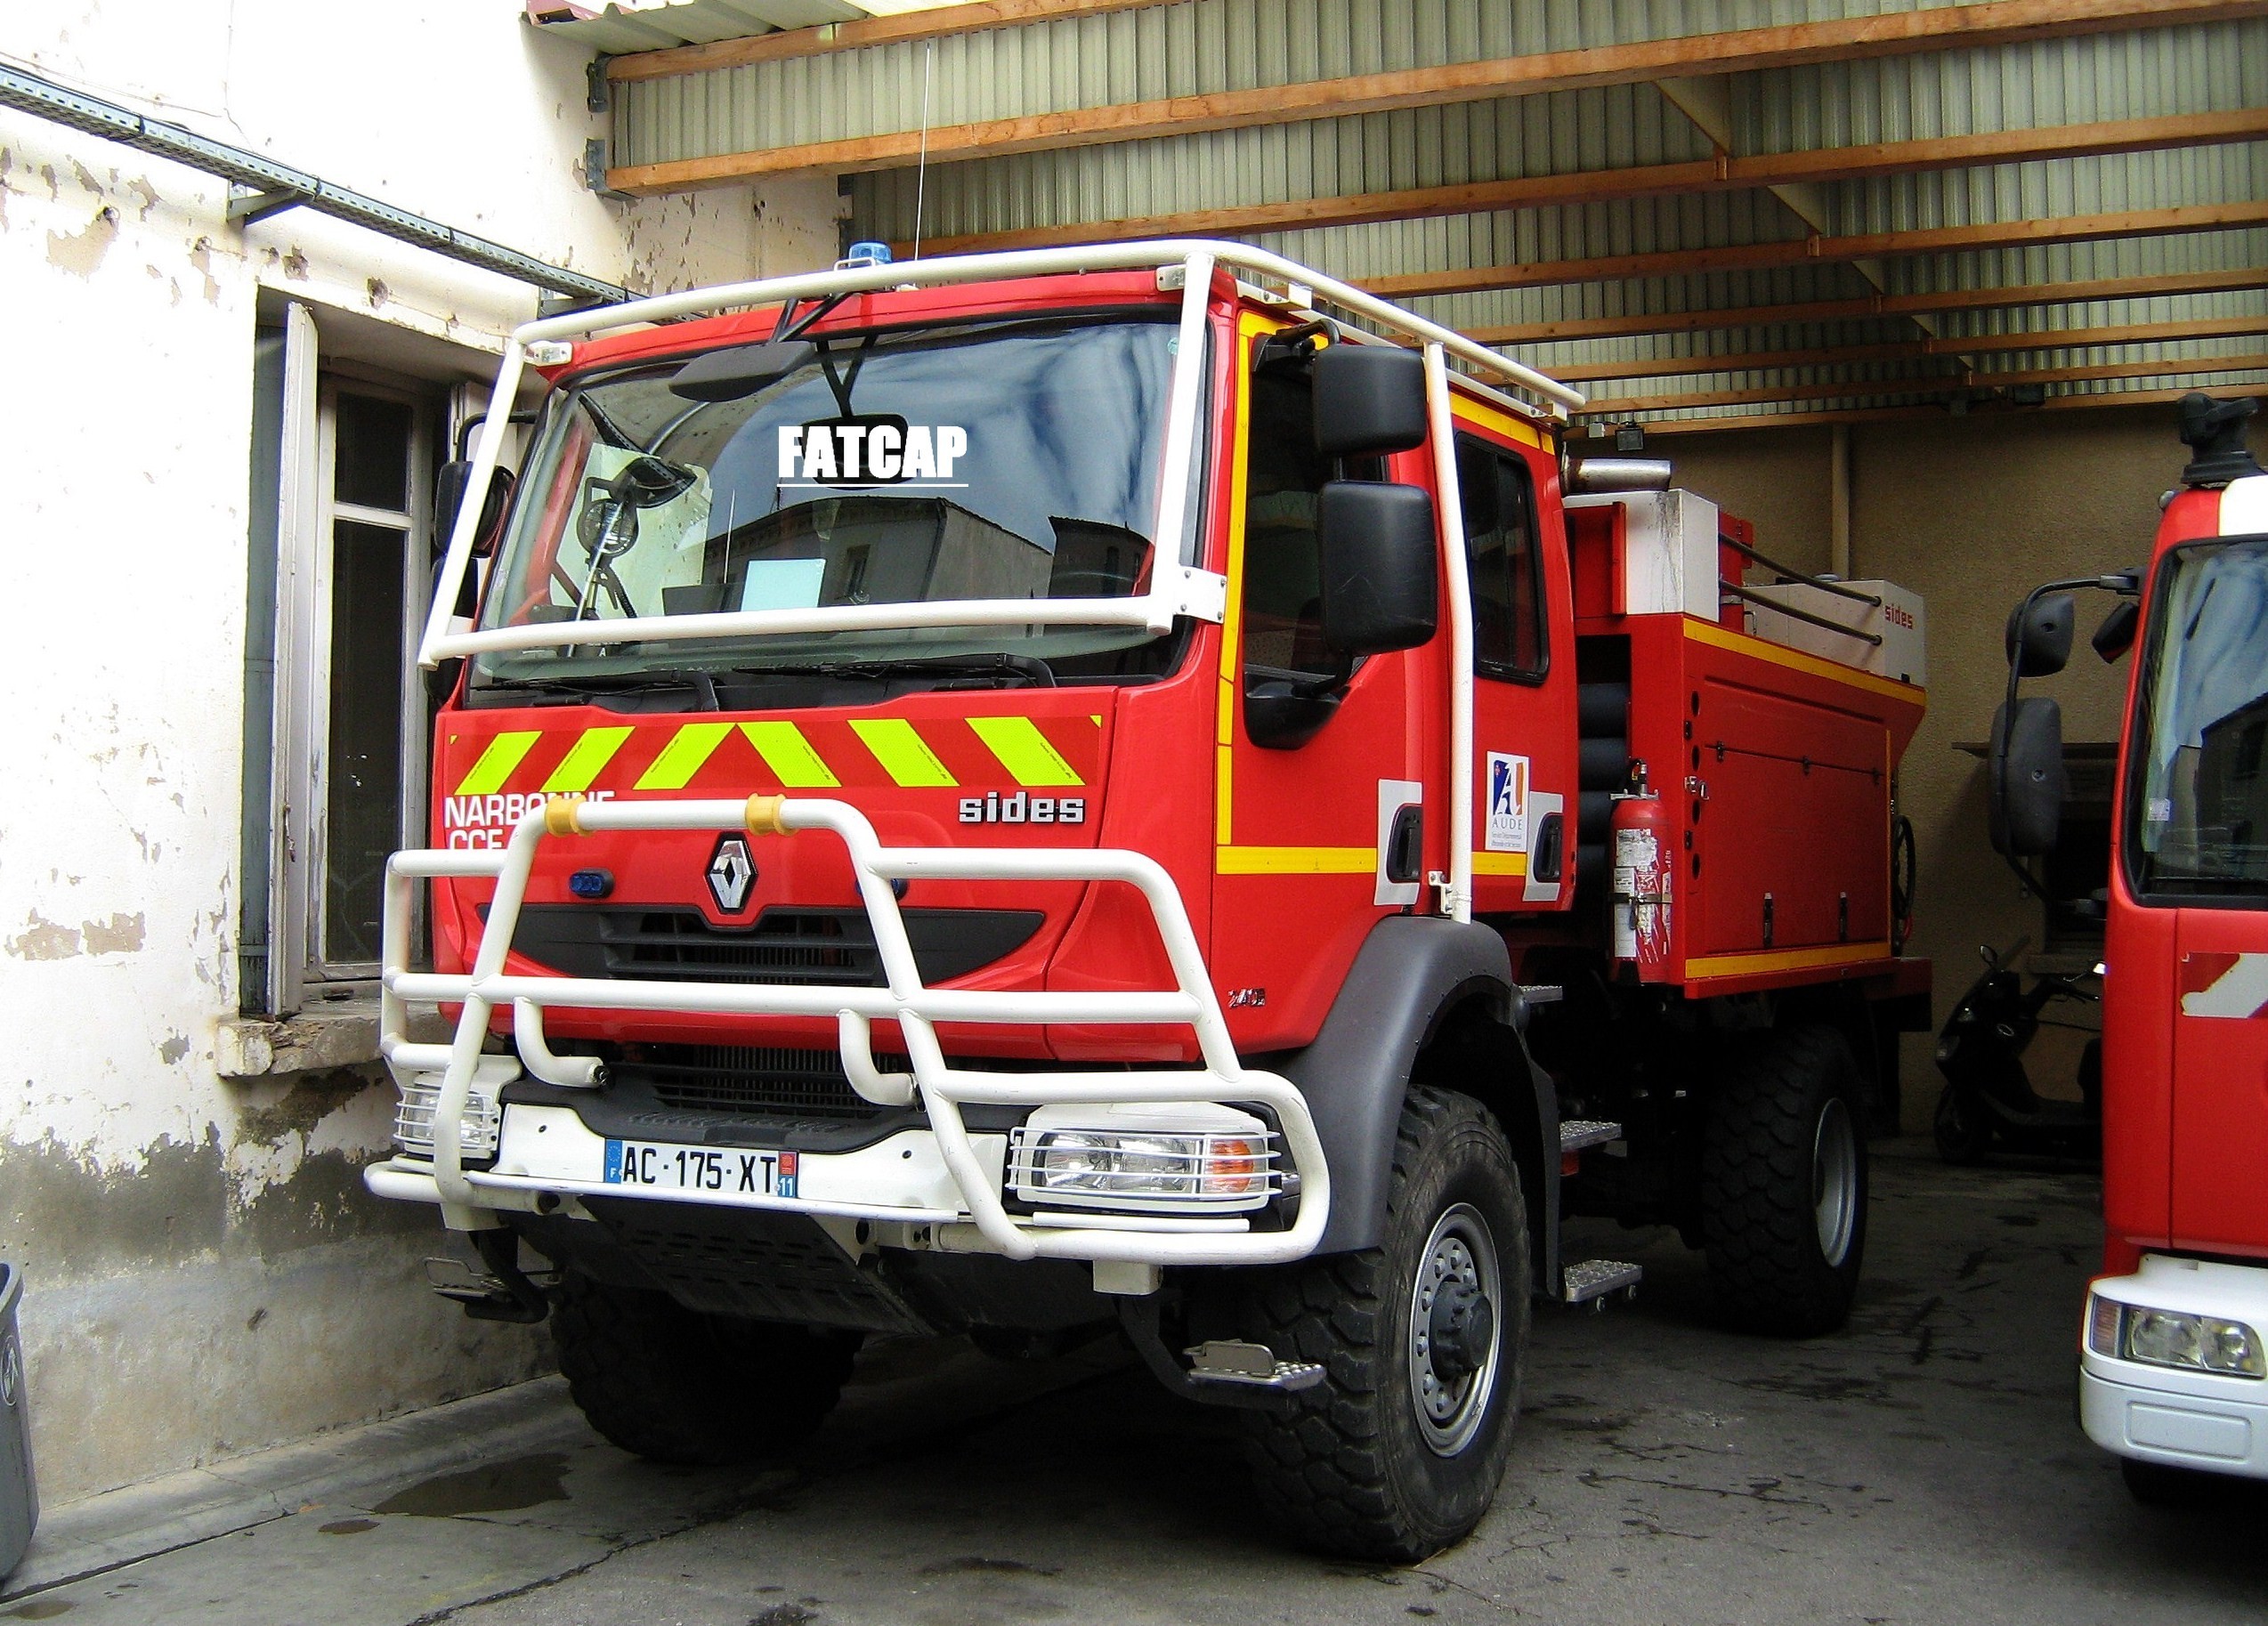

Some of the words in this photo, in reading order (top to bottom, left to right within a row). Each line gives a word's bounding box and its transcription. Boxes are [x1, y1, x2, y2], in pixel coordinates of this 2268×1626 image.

[1884, 603, 1913, 629] sides
[445, 789, 615, 829] NARB
[959, 791, 1084, 823] sides
[1492, 817, 1522, 829] AUDE
[610, 1168, 617, 1178] F
[779, 1177, 793, 1197] 11
